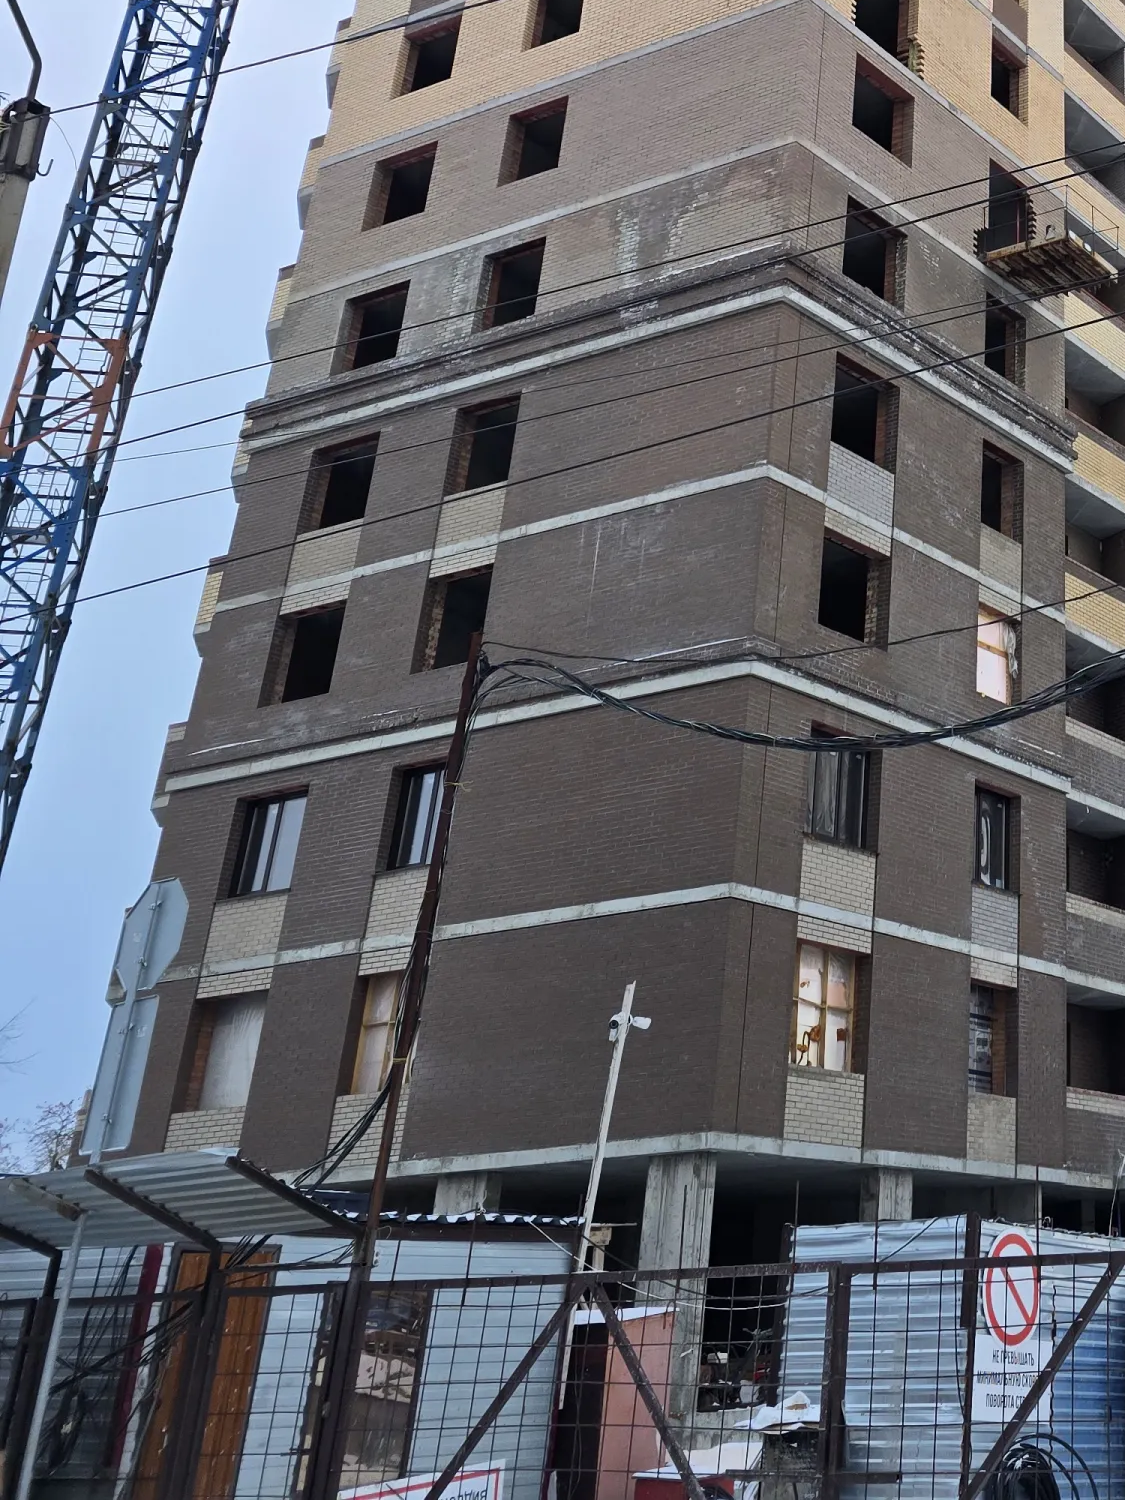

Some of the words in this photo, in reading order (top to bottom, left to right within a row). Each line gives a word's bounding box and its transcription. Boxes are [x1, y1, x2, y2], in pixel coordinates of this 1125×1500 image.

[992, 1349, 999, 1363] НЕ
[1000, 1350, 1034, 1366] ПРЕВЫШАТЬ
[985, 1393, 1014, 1408] ПОВОРОТА
